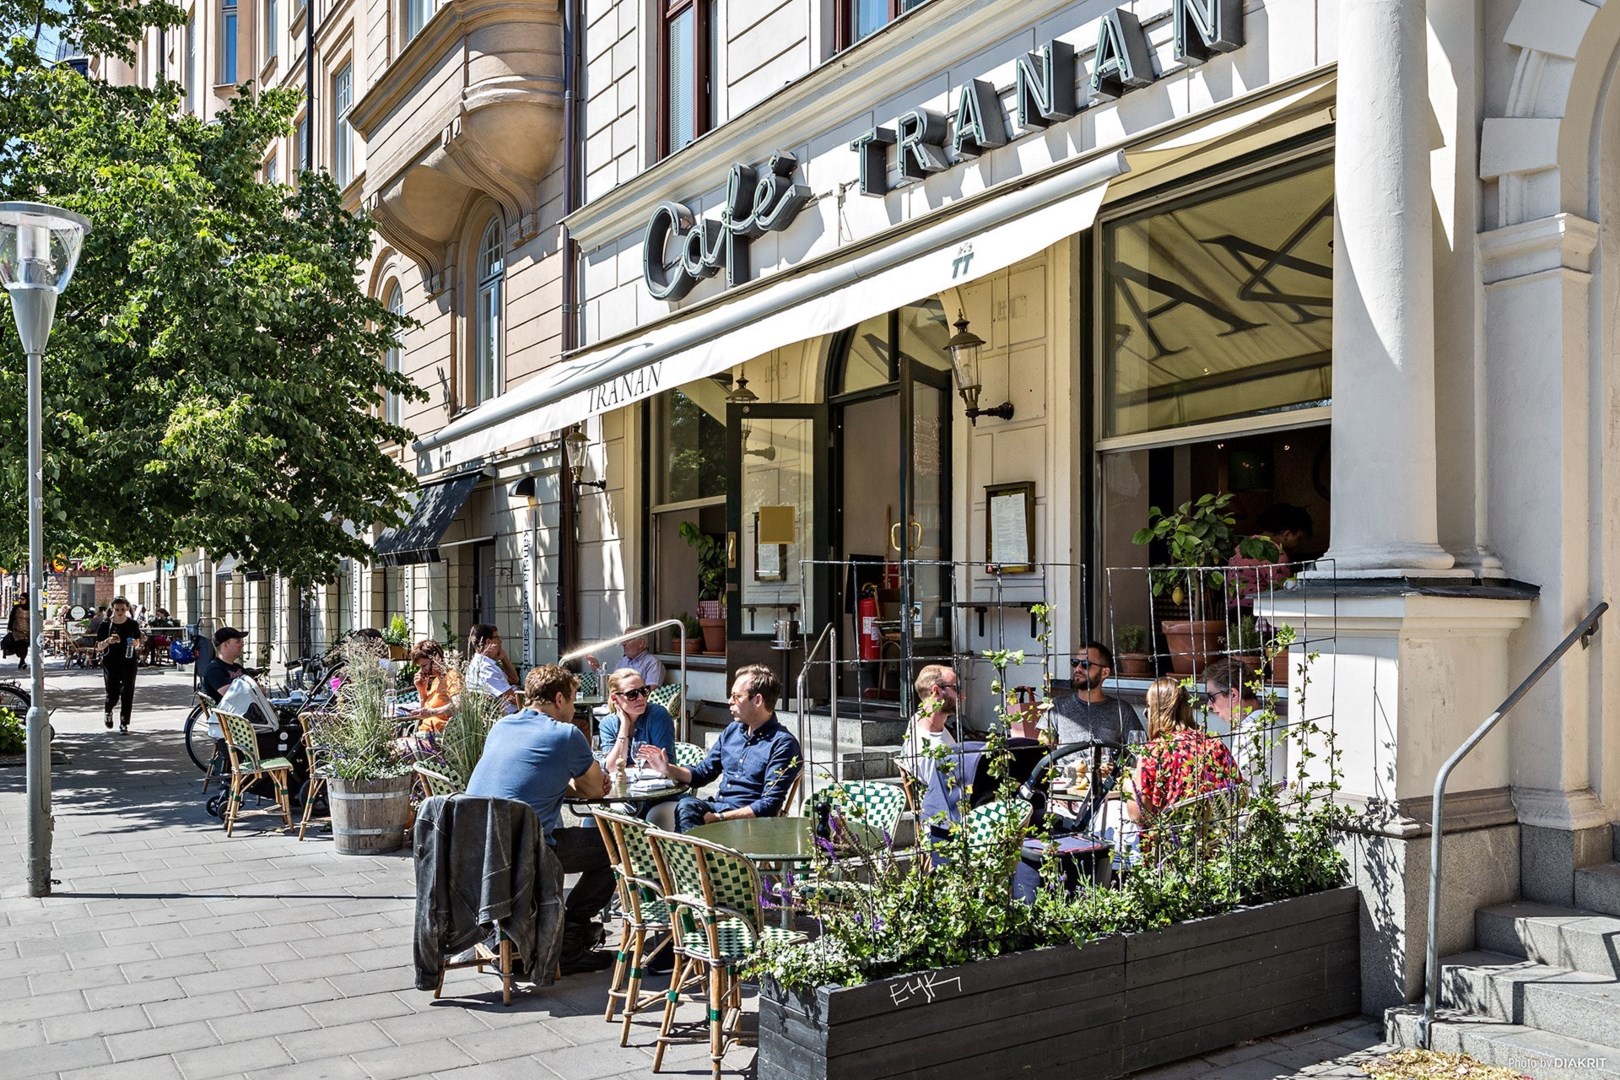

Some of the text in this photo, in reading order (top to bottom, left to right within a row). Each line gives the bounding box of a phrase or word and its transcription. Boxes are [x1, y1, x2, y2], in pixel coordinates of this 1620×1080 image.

[643, 0, 1243, 302] Café TRANAN
[588, 361, 663, 413] TRANAN
[523, 590, 531, 621] och
[523, 629, 532, 672] smak
